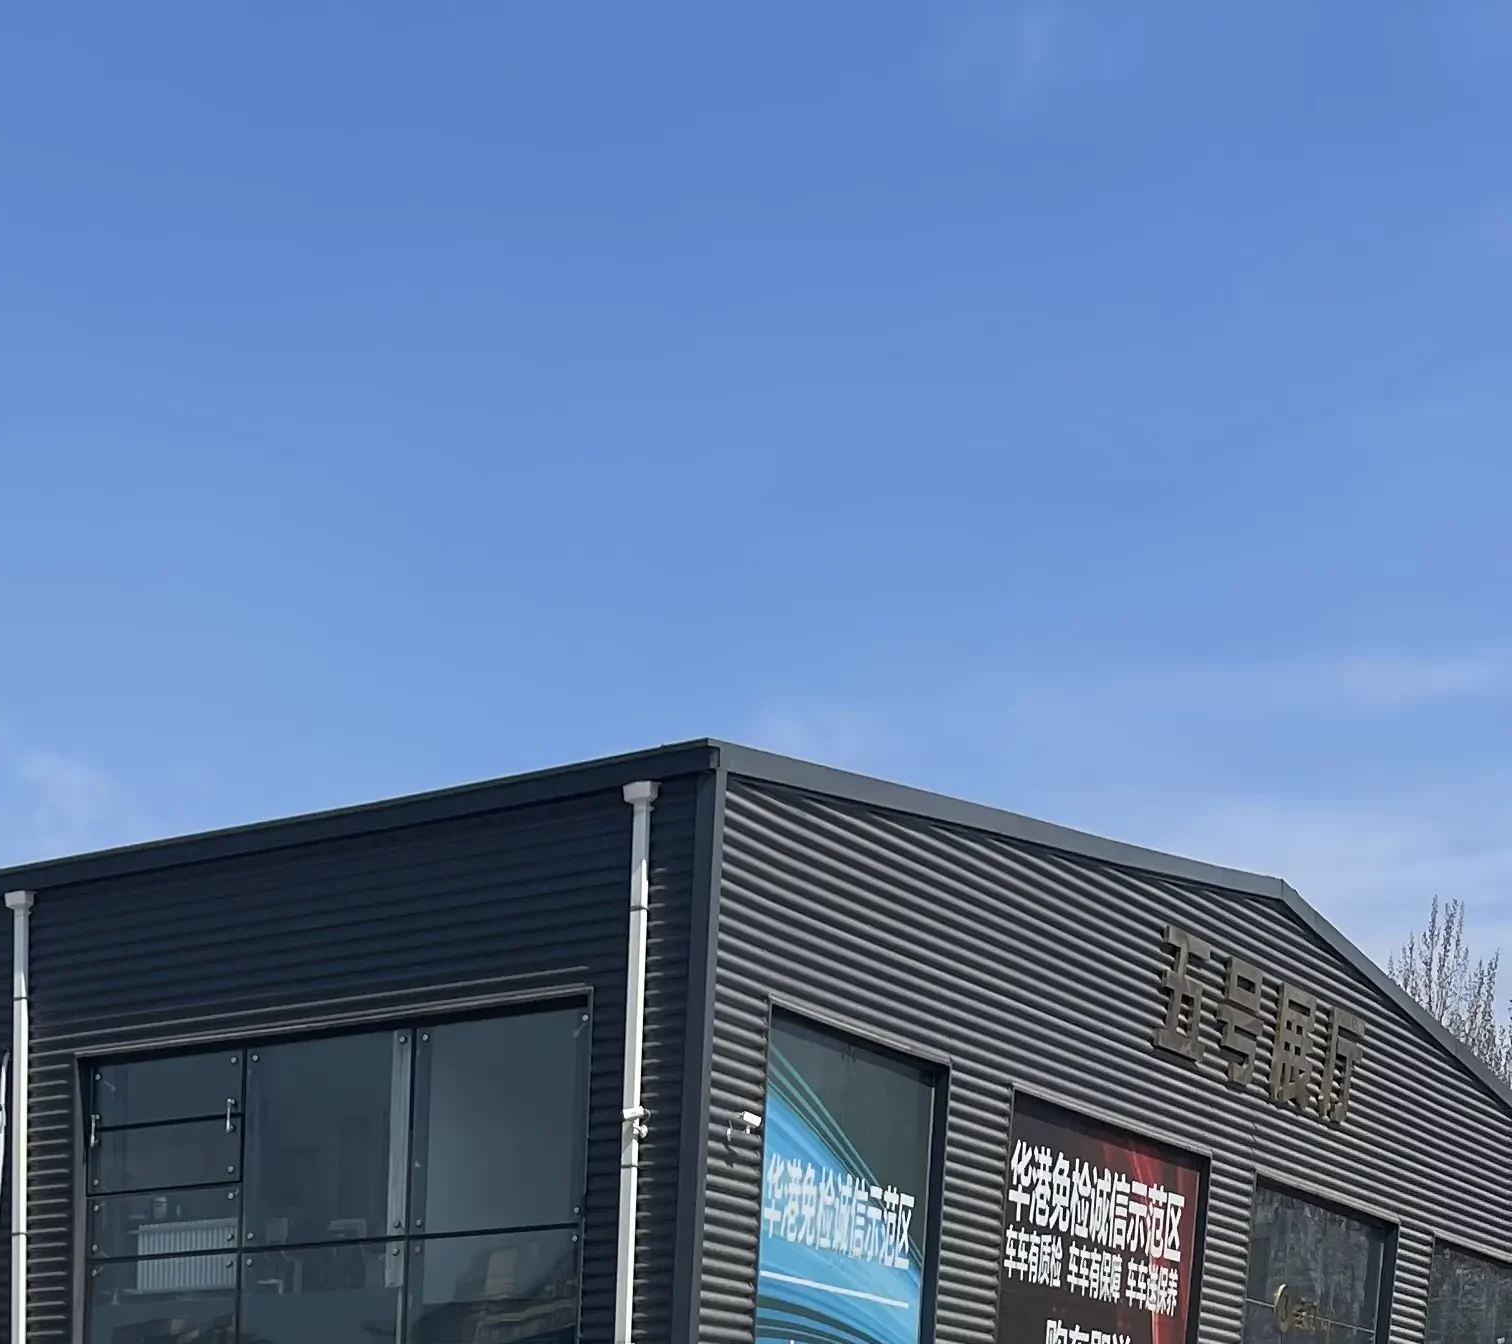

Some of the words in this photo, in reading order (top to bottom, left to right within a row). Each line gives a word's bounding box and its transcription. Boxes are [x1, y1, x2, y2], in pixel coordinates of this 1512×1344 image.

[1154, 924, 1366, 1125] 五号展厅
[764, 1152, 915, 1270] 华港免检诚信示范区
[1004, 1224, 1063, 1288] 车车有质检
[1008, 1139, 1185, 1262] 华港免检诚信示范区
